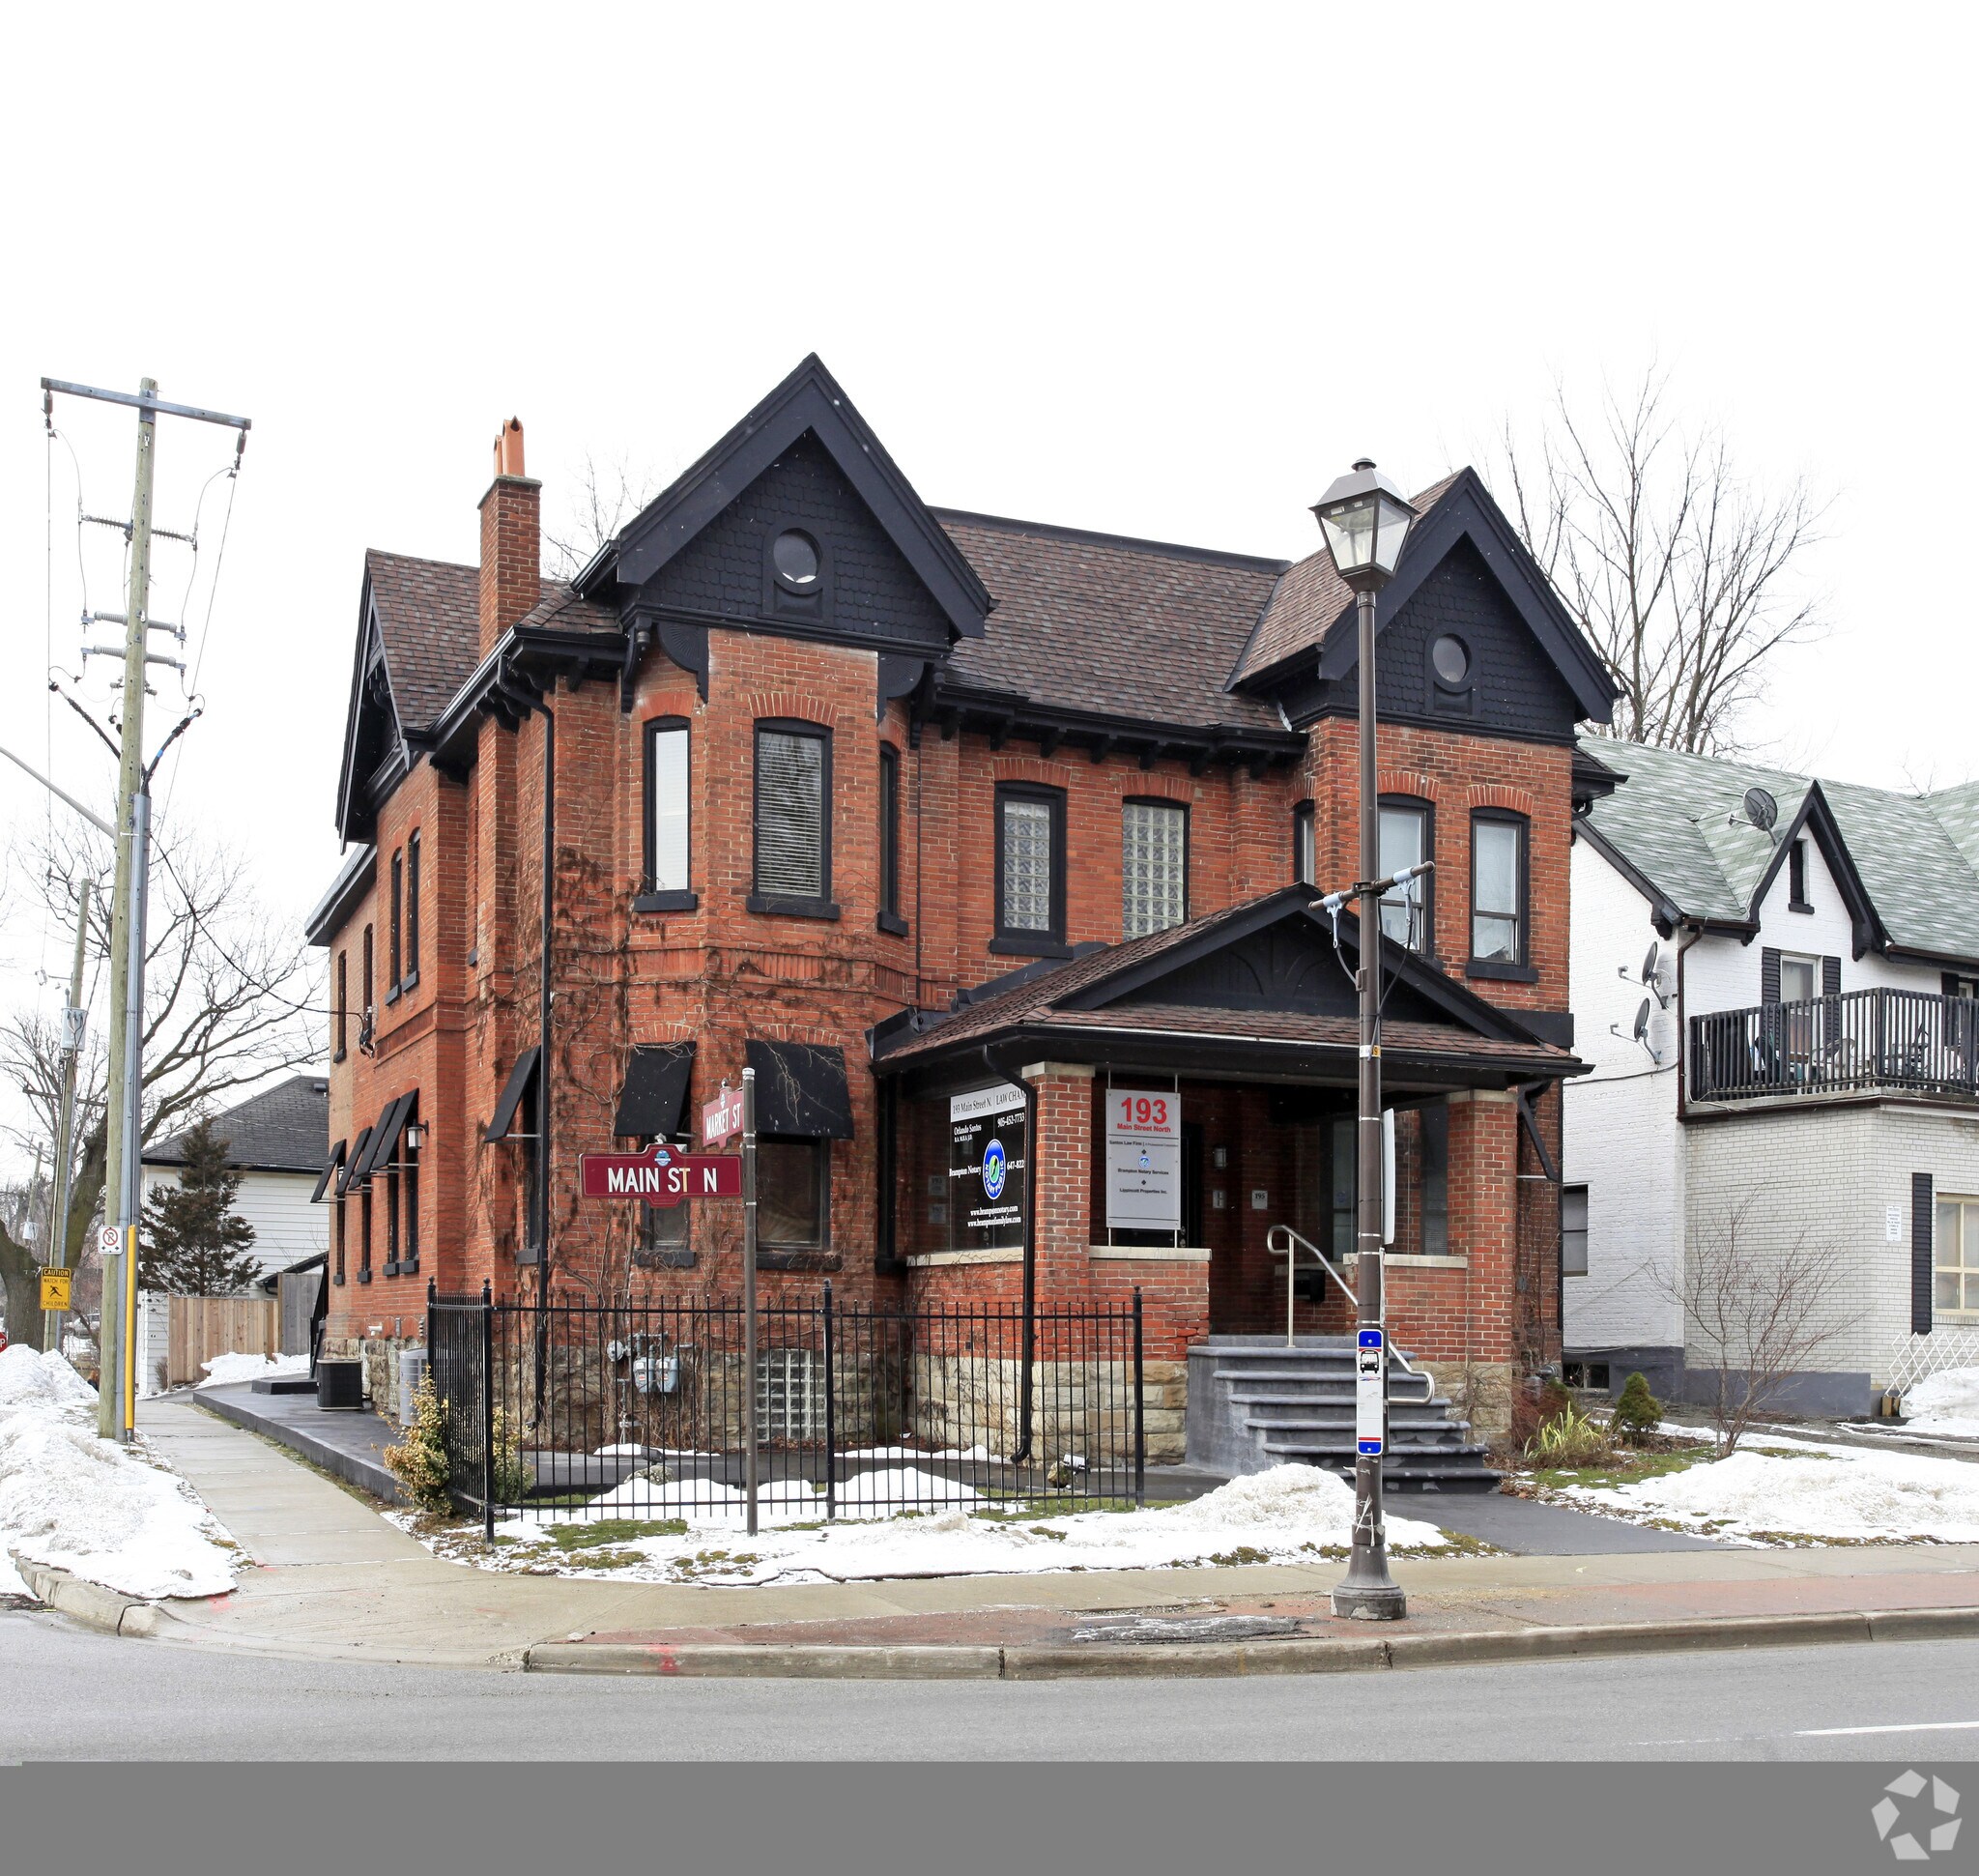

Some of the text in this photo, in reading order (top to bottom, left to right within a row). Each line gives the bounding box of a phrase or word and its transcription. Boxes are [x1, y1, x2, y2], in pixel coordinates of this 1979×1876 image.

[961, 1102, 972, 1112] Main
[973, 1099, 986, 1111] Street
[986, 1096, 992, 1107] N.
[995, 1092, 1008, 1106] LAW
[1121, 1097, 1167, 1125] 193
[706, 1103, 741, 1140] MARKET ST
[996, 1112, 1025, 1128] 905-452-7733
[1117, 1122, 1132, 1131] Main
[1133, 1123, 1152, 1132] Street
[954, 1123, 982, 1136] Orlando Santos
[949, 1165, 982, 1178] Brampton Notary
[986, 1164, 994, 1194] NOTARY
[608, 1167, 718, 1193] MAIN ST N
